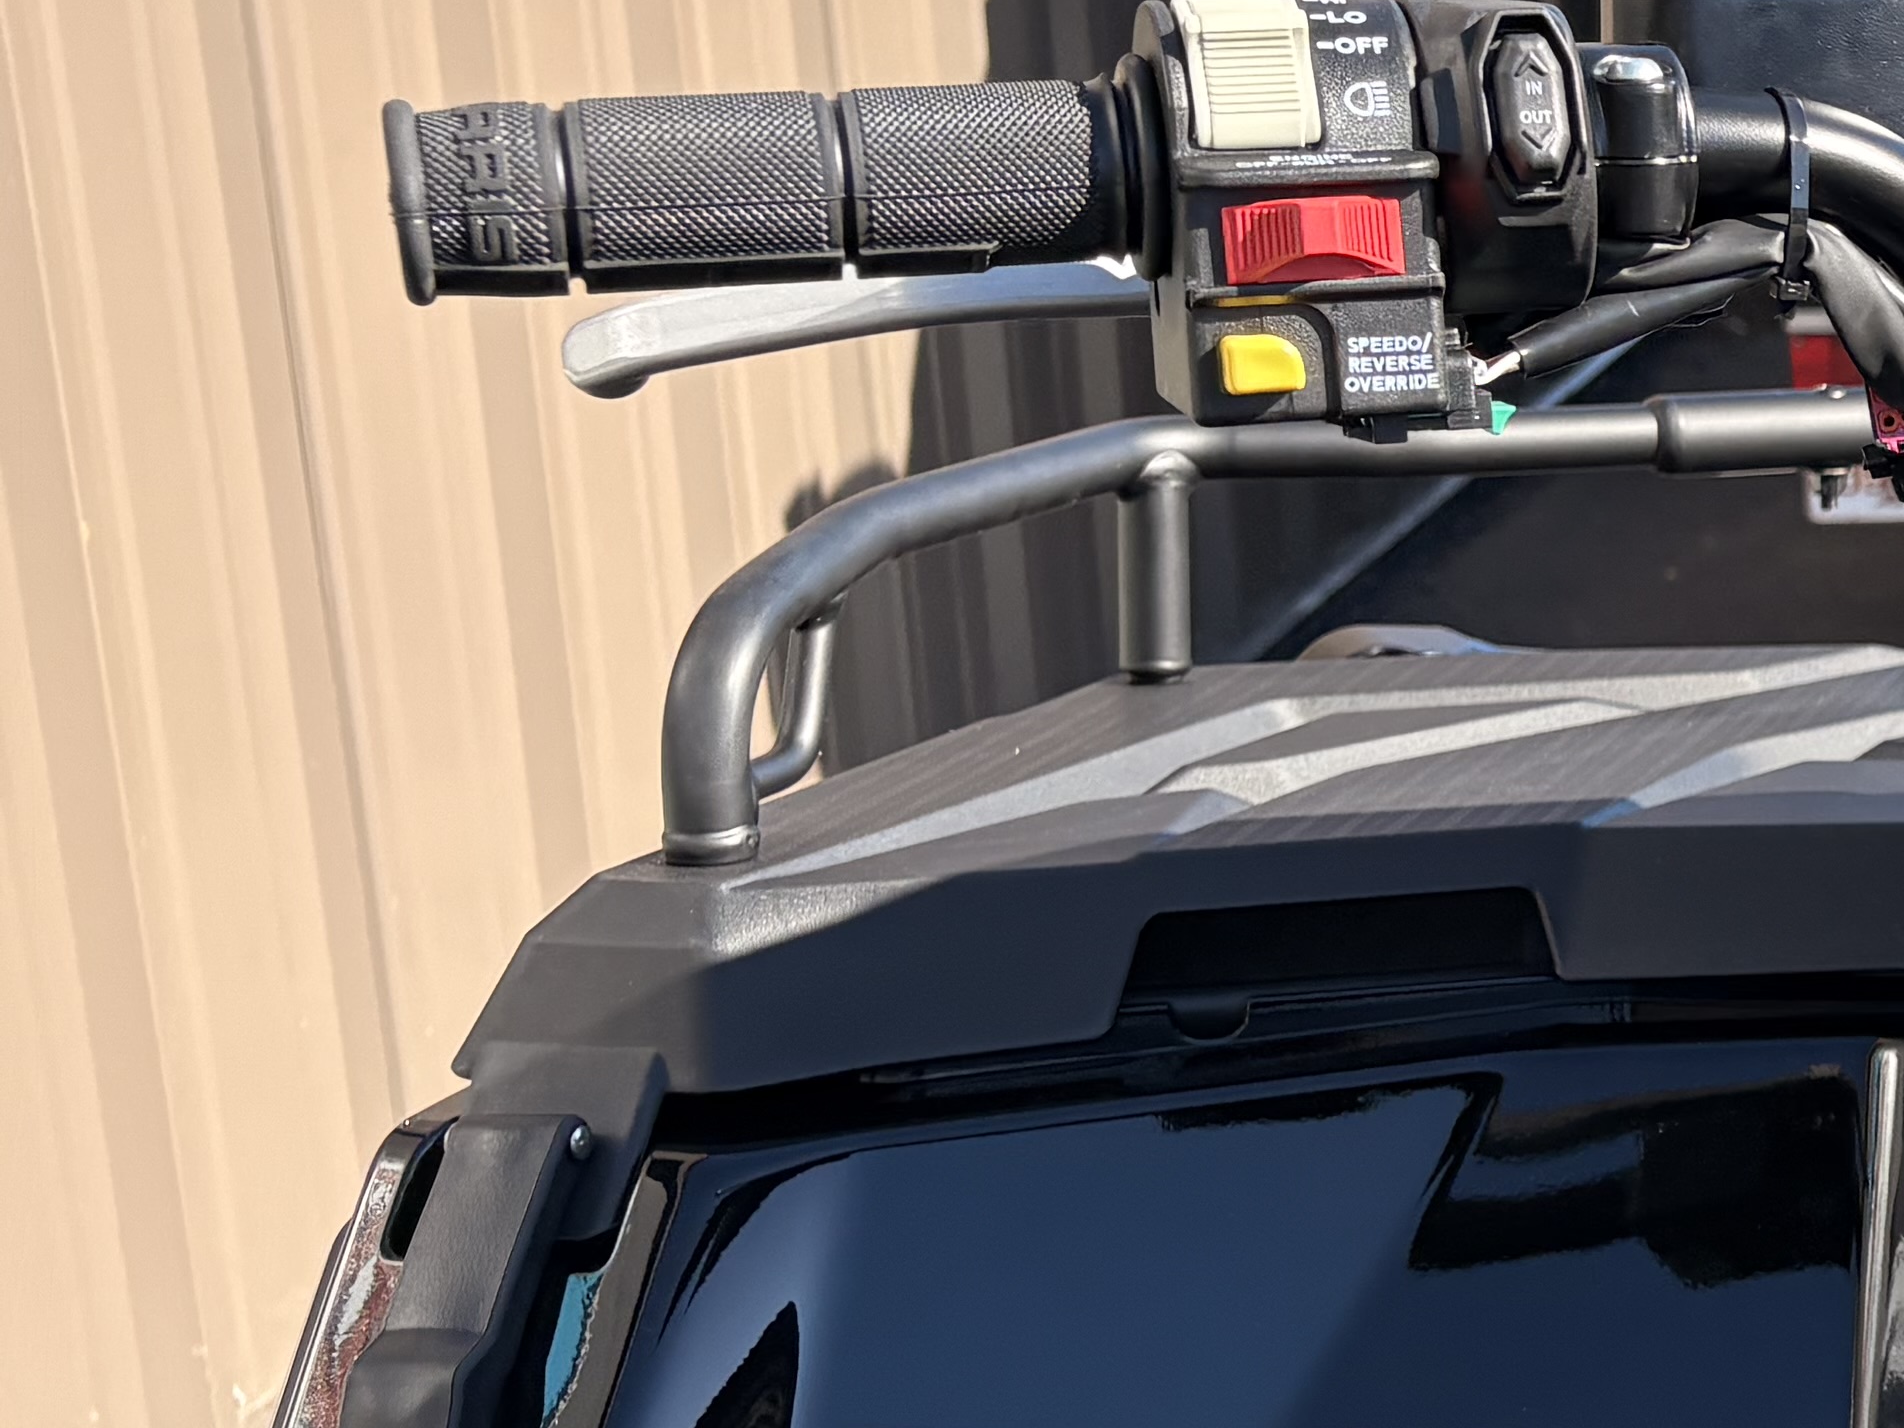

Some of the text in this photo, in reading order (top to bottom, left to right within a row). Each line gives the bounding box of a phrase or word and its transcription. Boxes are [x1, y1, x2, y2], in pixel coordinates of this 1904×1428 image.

[1325, 10, 1368, 25] LO
[1334, 36, 1389, 55] OFF
[1525, 80, 1543, 97] IN
[1519, 109, 1553, 125] OUT
[1347, 331, 1433, 353] SPEEDO/
[1348, 354, 1434, 373] REVERSE
[1344, 373, 1441, 393] OVERRIDE
